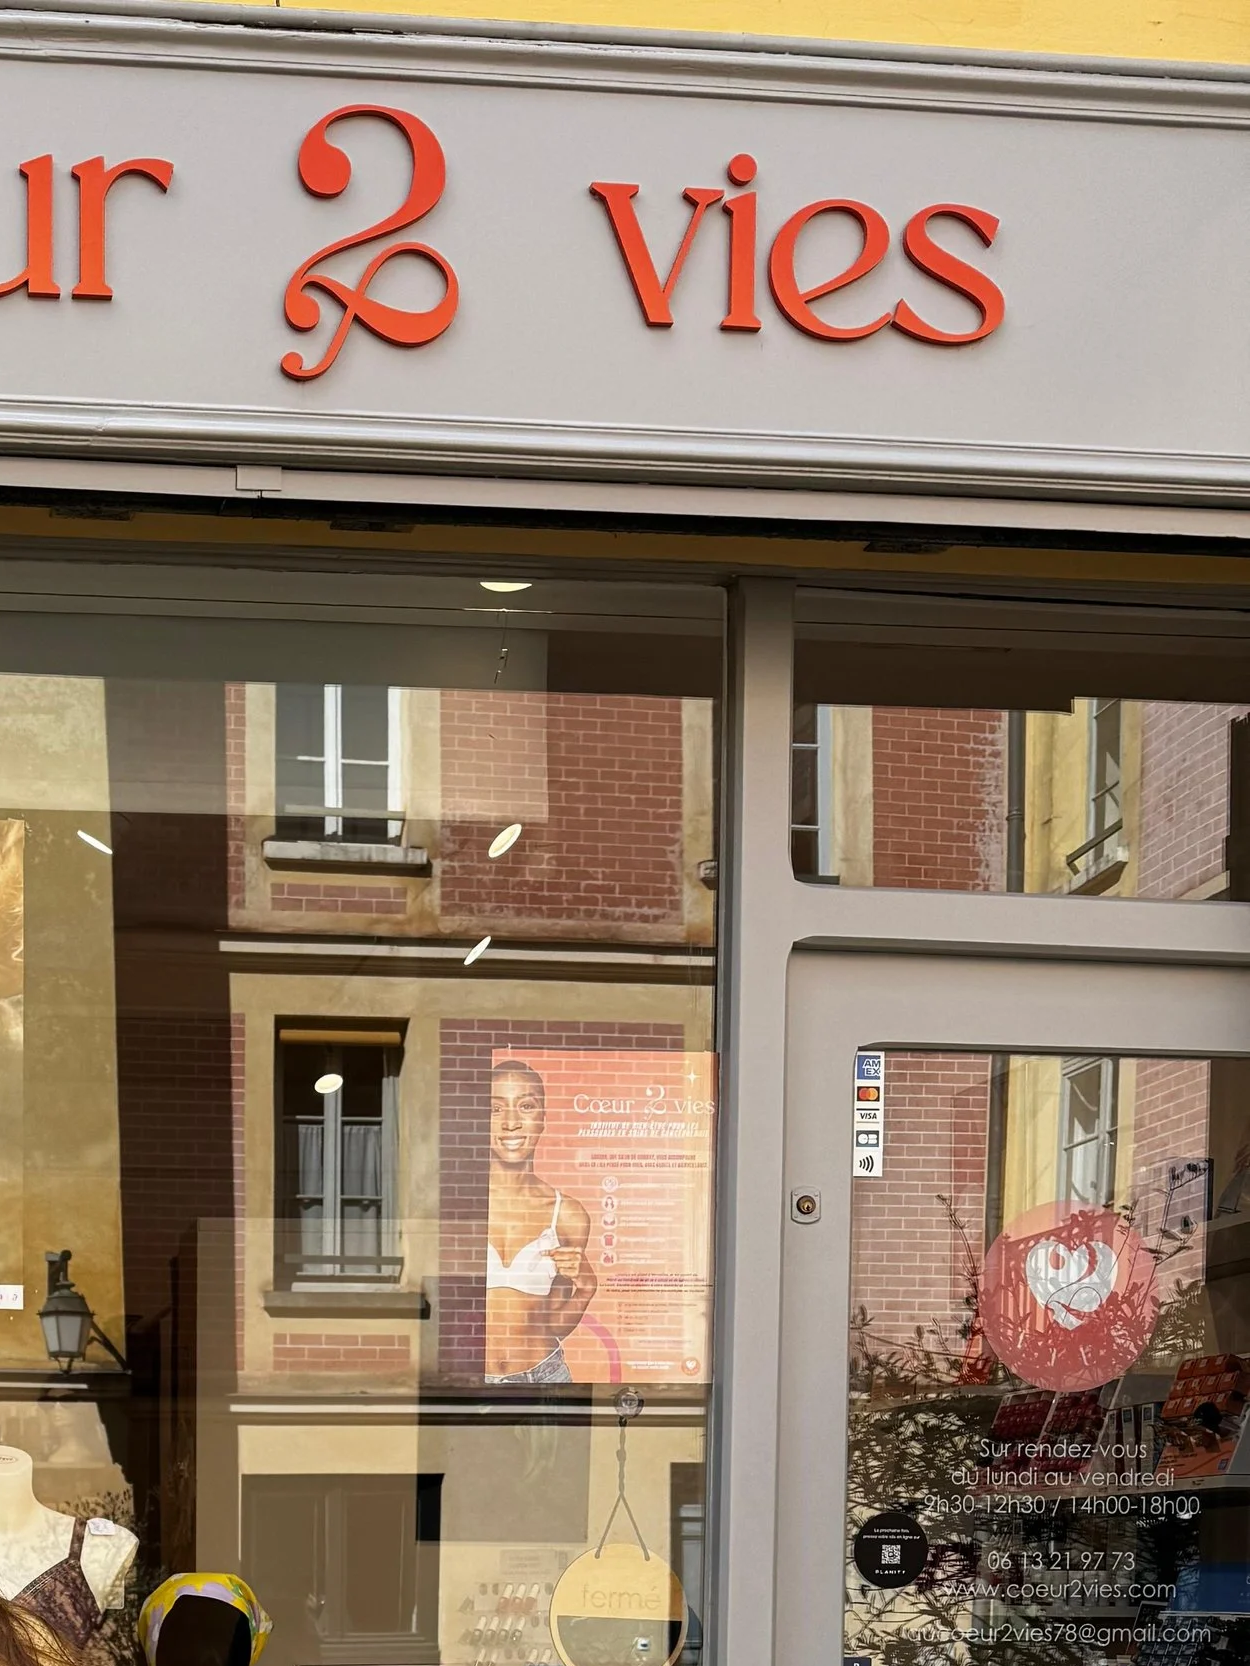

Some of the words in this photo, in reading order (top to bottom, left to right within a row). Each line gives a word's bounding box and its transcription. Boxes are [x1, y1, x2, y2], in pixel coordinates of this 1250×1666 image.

[279, 103, 461, 382] 2
[588, 152, 1005, 348] vies
[674, 1096, 715, 1114] vies
[859, 1112, 877, 1120] VISA
[979, 1439, 1012, 1458] Sur
[1017, 1439, 1147, 1458] rendez-vous
[951, 1466, 980, 1486] du
[986, 1466, 1038, 1486] lundi
[1045, 1471, 1074, 1486] au
[1079, 1467, 1175, 1488] vendredi
[924, 1494, 1046, 1515] 9h30-12h30
[1052, 1495, 1061, 1517] /
[986, 1552, 1012, 1571] 06
[1022, 1552, 1044, 1571] 13
[1050, 1552, 1072, 1571] 21
[1080, 1552, 1106, 1571] 97
[1112, 1552, 1136, 1571] 73
[581, 1583, 662, 1611] fermé
[943, 1580, 1177, 1600] www.coeur2vies.com
